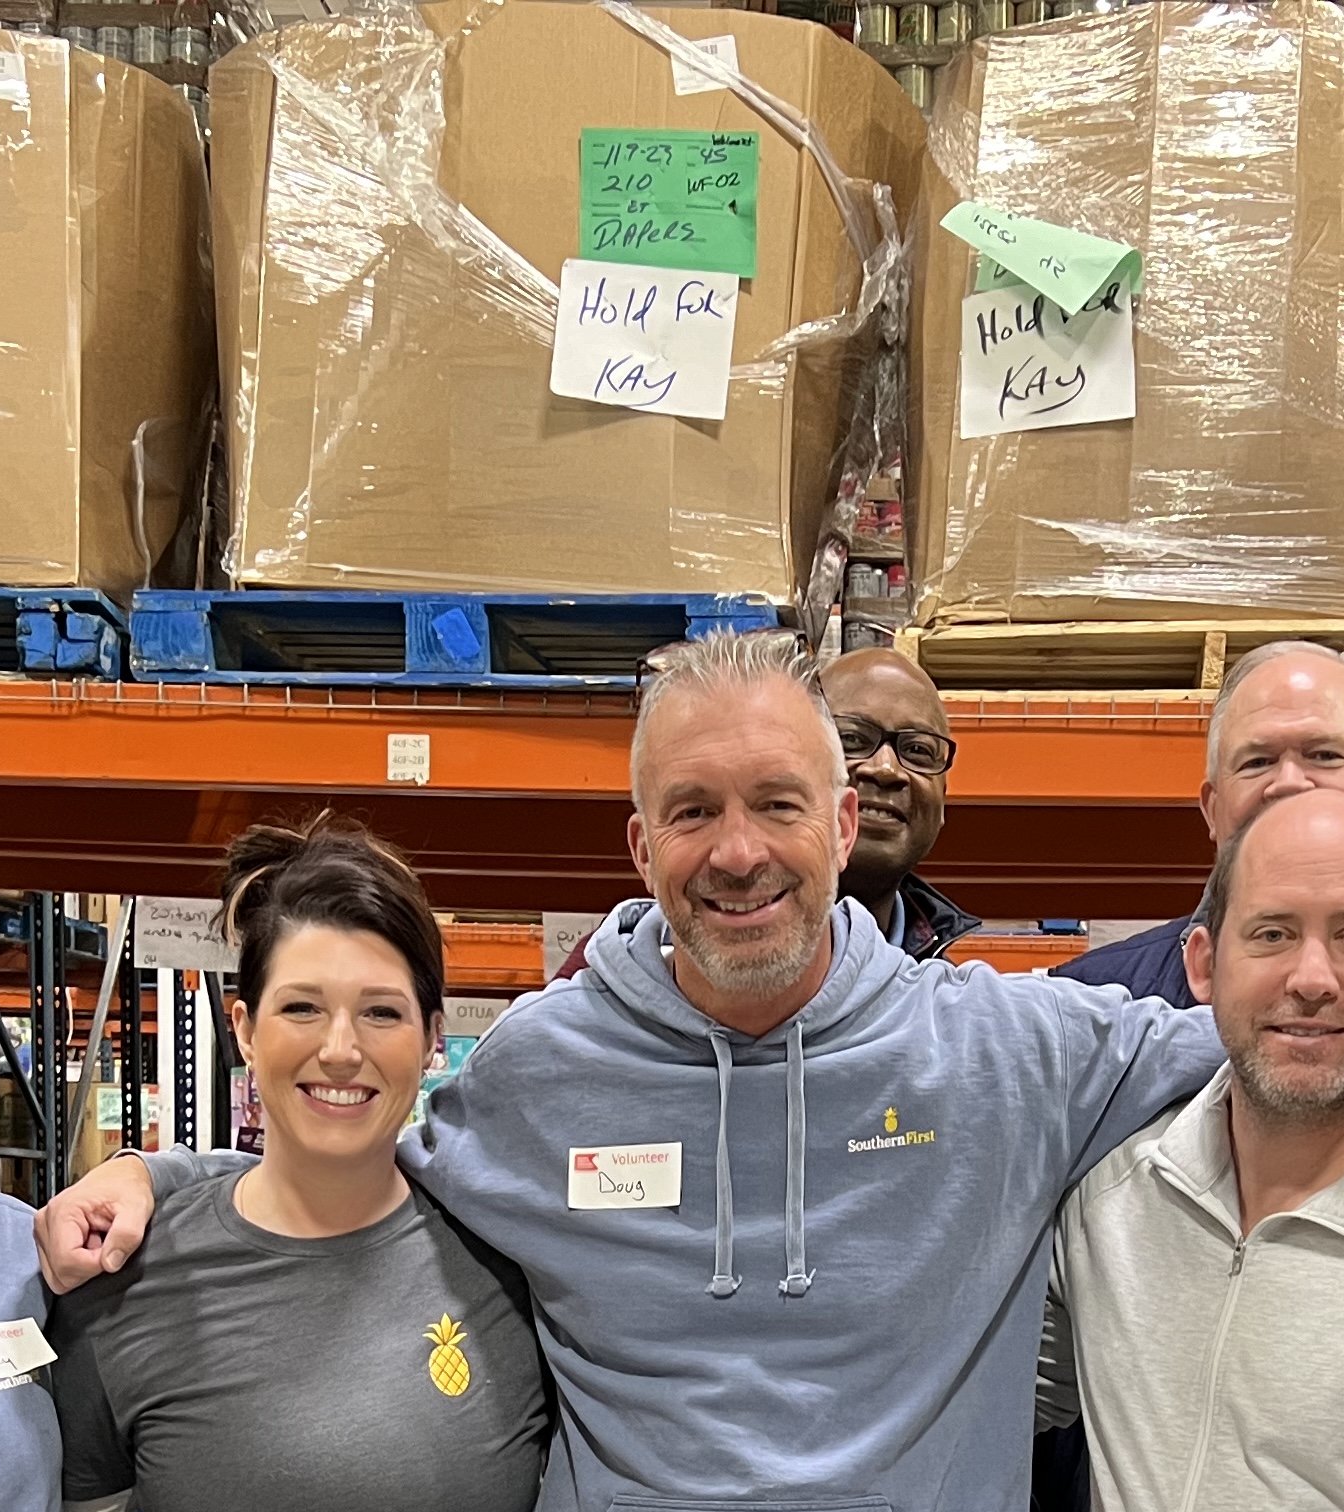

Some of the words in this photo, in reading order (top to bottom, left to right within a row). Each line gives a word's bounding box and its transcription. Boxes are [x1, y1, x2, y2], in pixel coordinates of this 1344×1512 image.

[700, 147, 728, 165] 45
[601, 173, 653, 193] 210
[578, 277, 658, 335] Hold
[976, 296, 1046, 356] Hold
[847, 1129, 936, 1153] SouthernFirst
[612, 1152, 669, 1166] Volunteer
[598, 1171, 646, 1202] Doug
